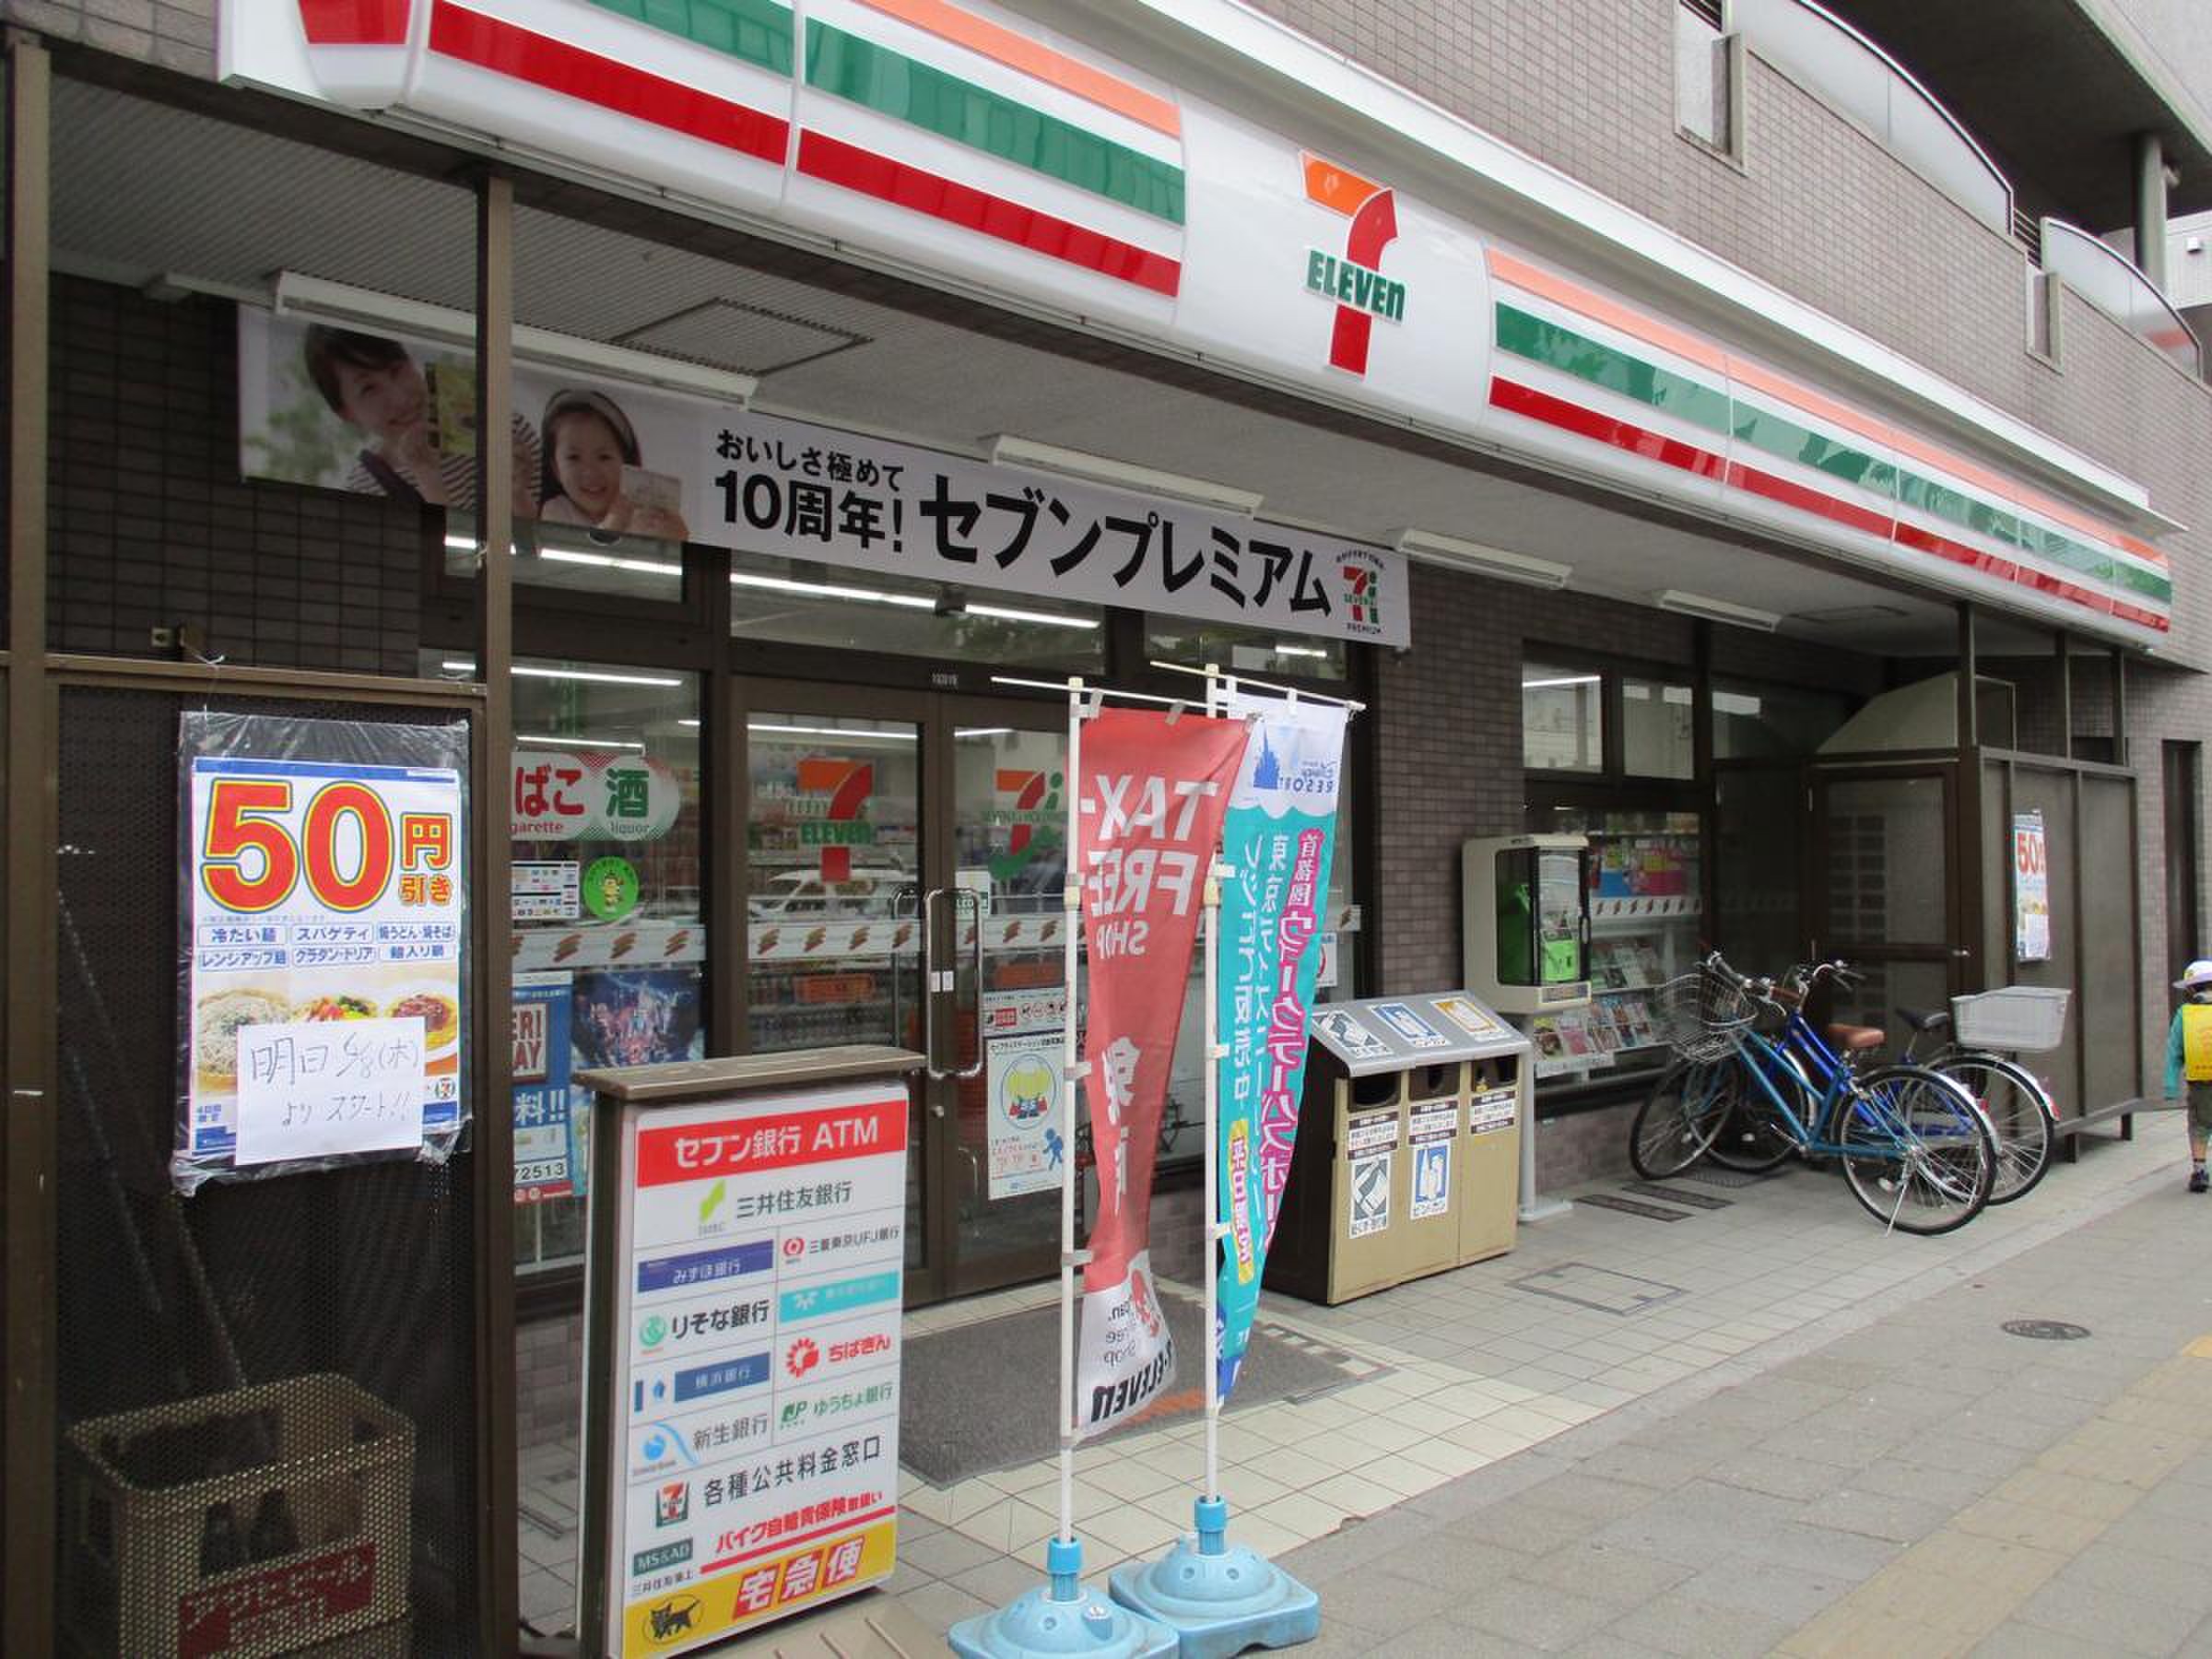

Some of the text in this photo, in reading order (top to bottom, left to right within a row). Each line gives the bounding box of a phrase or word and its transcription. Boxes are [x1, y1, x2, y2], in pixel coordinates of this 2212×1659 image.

[716, 429, 904, 492] おいしさ極めて
[919, 473, 1332, 617] セブンプレミアム
[606, 767, 650, 818] 酒
[398, 877, 453, 906] 引き
[251, 1037, 329, 1086] 明日
[675, 1116, 879, 1169] セブン銀行 ATM
[736, 1181, 853, 1219] 三井住友銀行
[672, 1258, 742, 1285] みずほ銀行
[671, 1299, 771, 1340] りそな銀行
[827, 1334, 892, 1363] ちばぎん
[695, 1364, 753, 1388] 横浜銀行
[812, 1382, 894, 1418] ゆうちょ銀行
[692, 1413, 769, 1453] 新生銀行
[703, 1434, 881, 1508] 各種公共料金窓口
[637, 1543, 690, 1571] MS&AD
[735, 1536, 865, 1619] 宅急便
